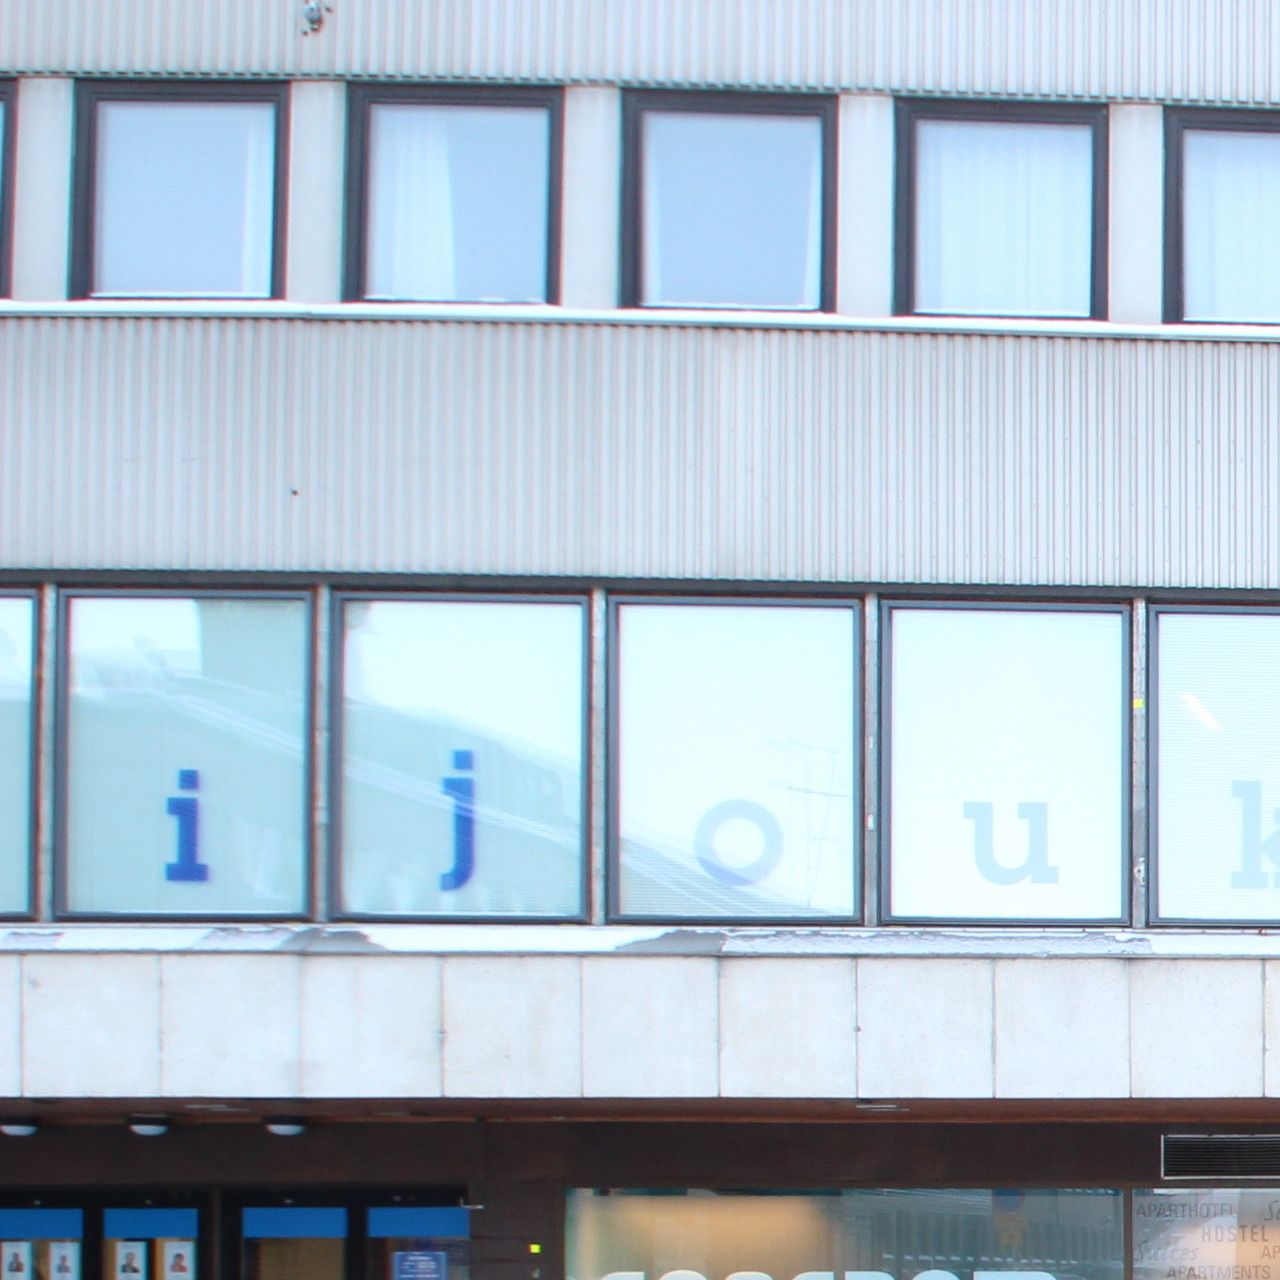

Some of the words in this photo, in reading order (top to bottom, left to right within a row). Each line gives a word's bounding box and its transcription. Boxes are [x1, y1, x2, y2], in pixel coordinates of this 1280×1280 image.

[1137, 1203, 1233, 1217] APARTHOTEL
[1201, 1225, 1269, 1242] HOSTEL
[1167, 1265, 1271, 1280] APARTMENTS
